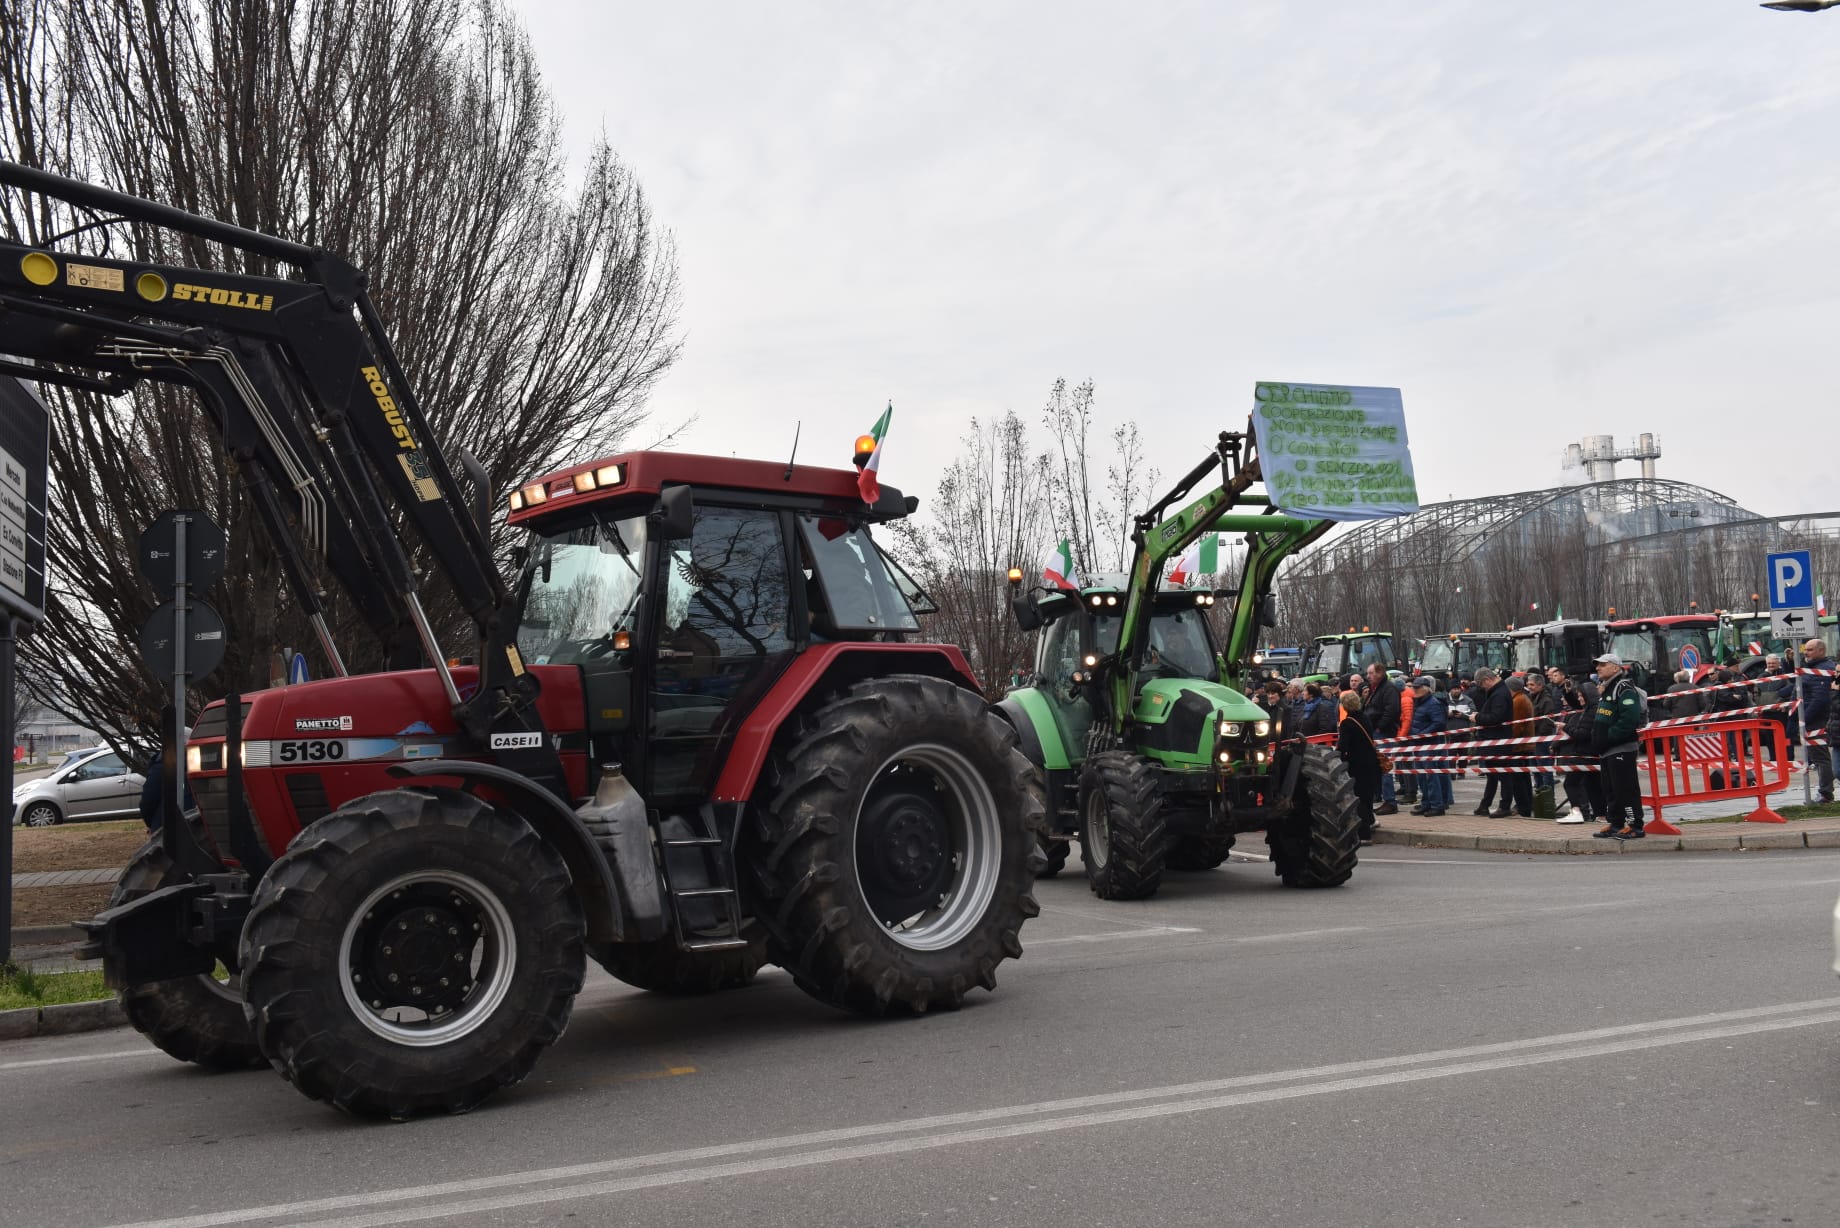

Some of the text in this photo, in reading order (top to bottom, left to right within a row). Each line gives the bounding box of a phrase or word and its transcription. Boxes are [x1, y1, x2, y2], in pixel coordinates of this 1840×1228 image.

[172, 284, 262, 311] STOLL
[360, 366, 417, 450] ROBUST
[2, 557, 18, 582] Stazione
[1775, 557, 1803, 604] P
[296, 719, 340, 729] PANETTO
[279, 740, 344, 763] 5130
